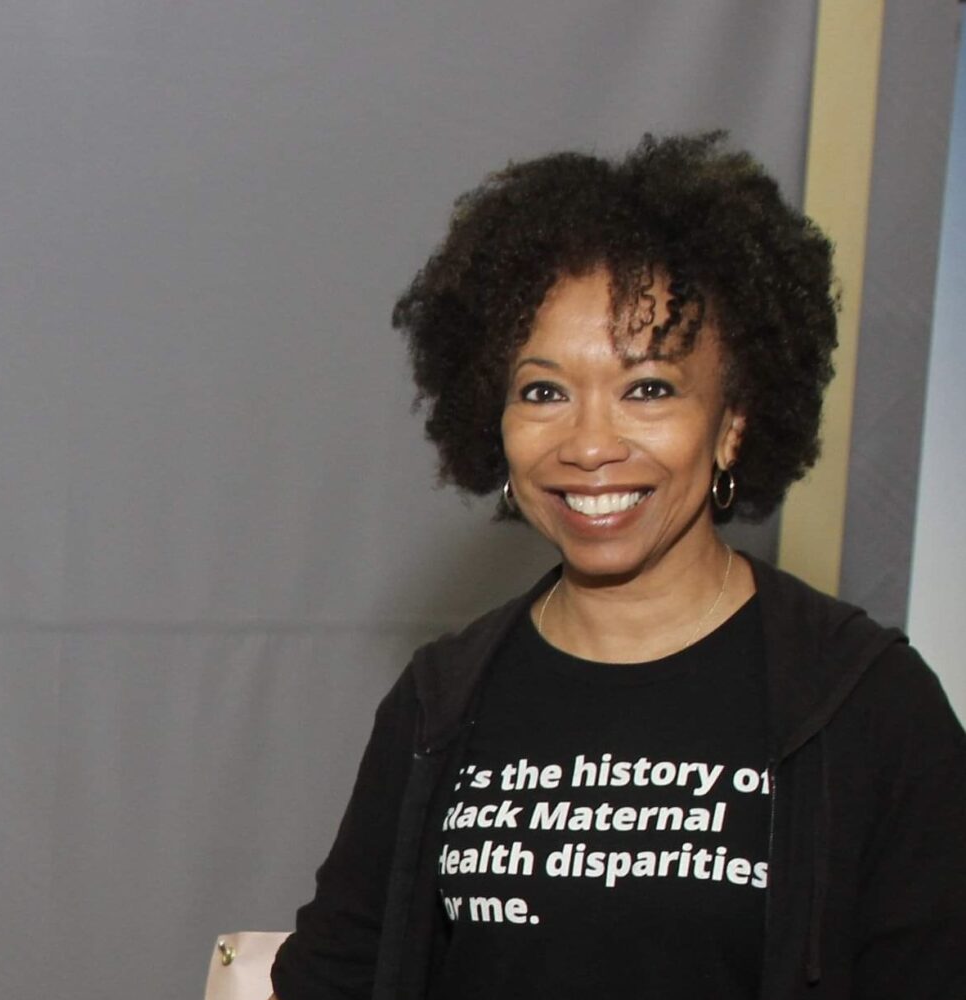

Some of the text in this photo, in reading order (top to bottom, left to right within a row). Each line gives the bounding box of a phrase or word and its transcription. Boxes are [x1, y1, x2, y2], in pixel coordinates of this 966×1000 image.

[501, 759, 562, 792] the
[571, 753, 724, 797] history
[529, 801, 727, 833] Maternal
[545, 843, 769, 888] disparities
[469, 895, 540, 925] me.
